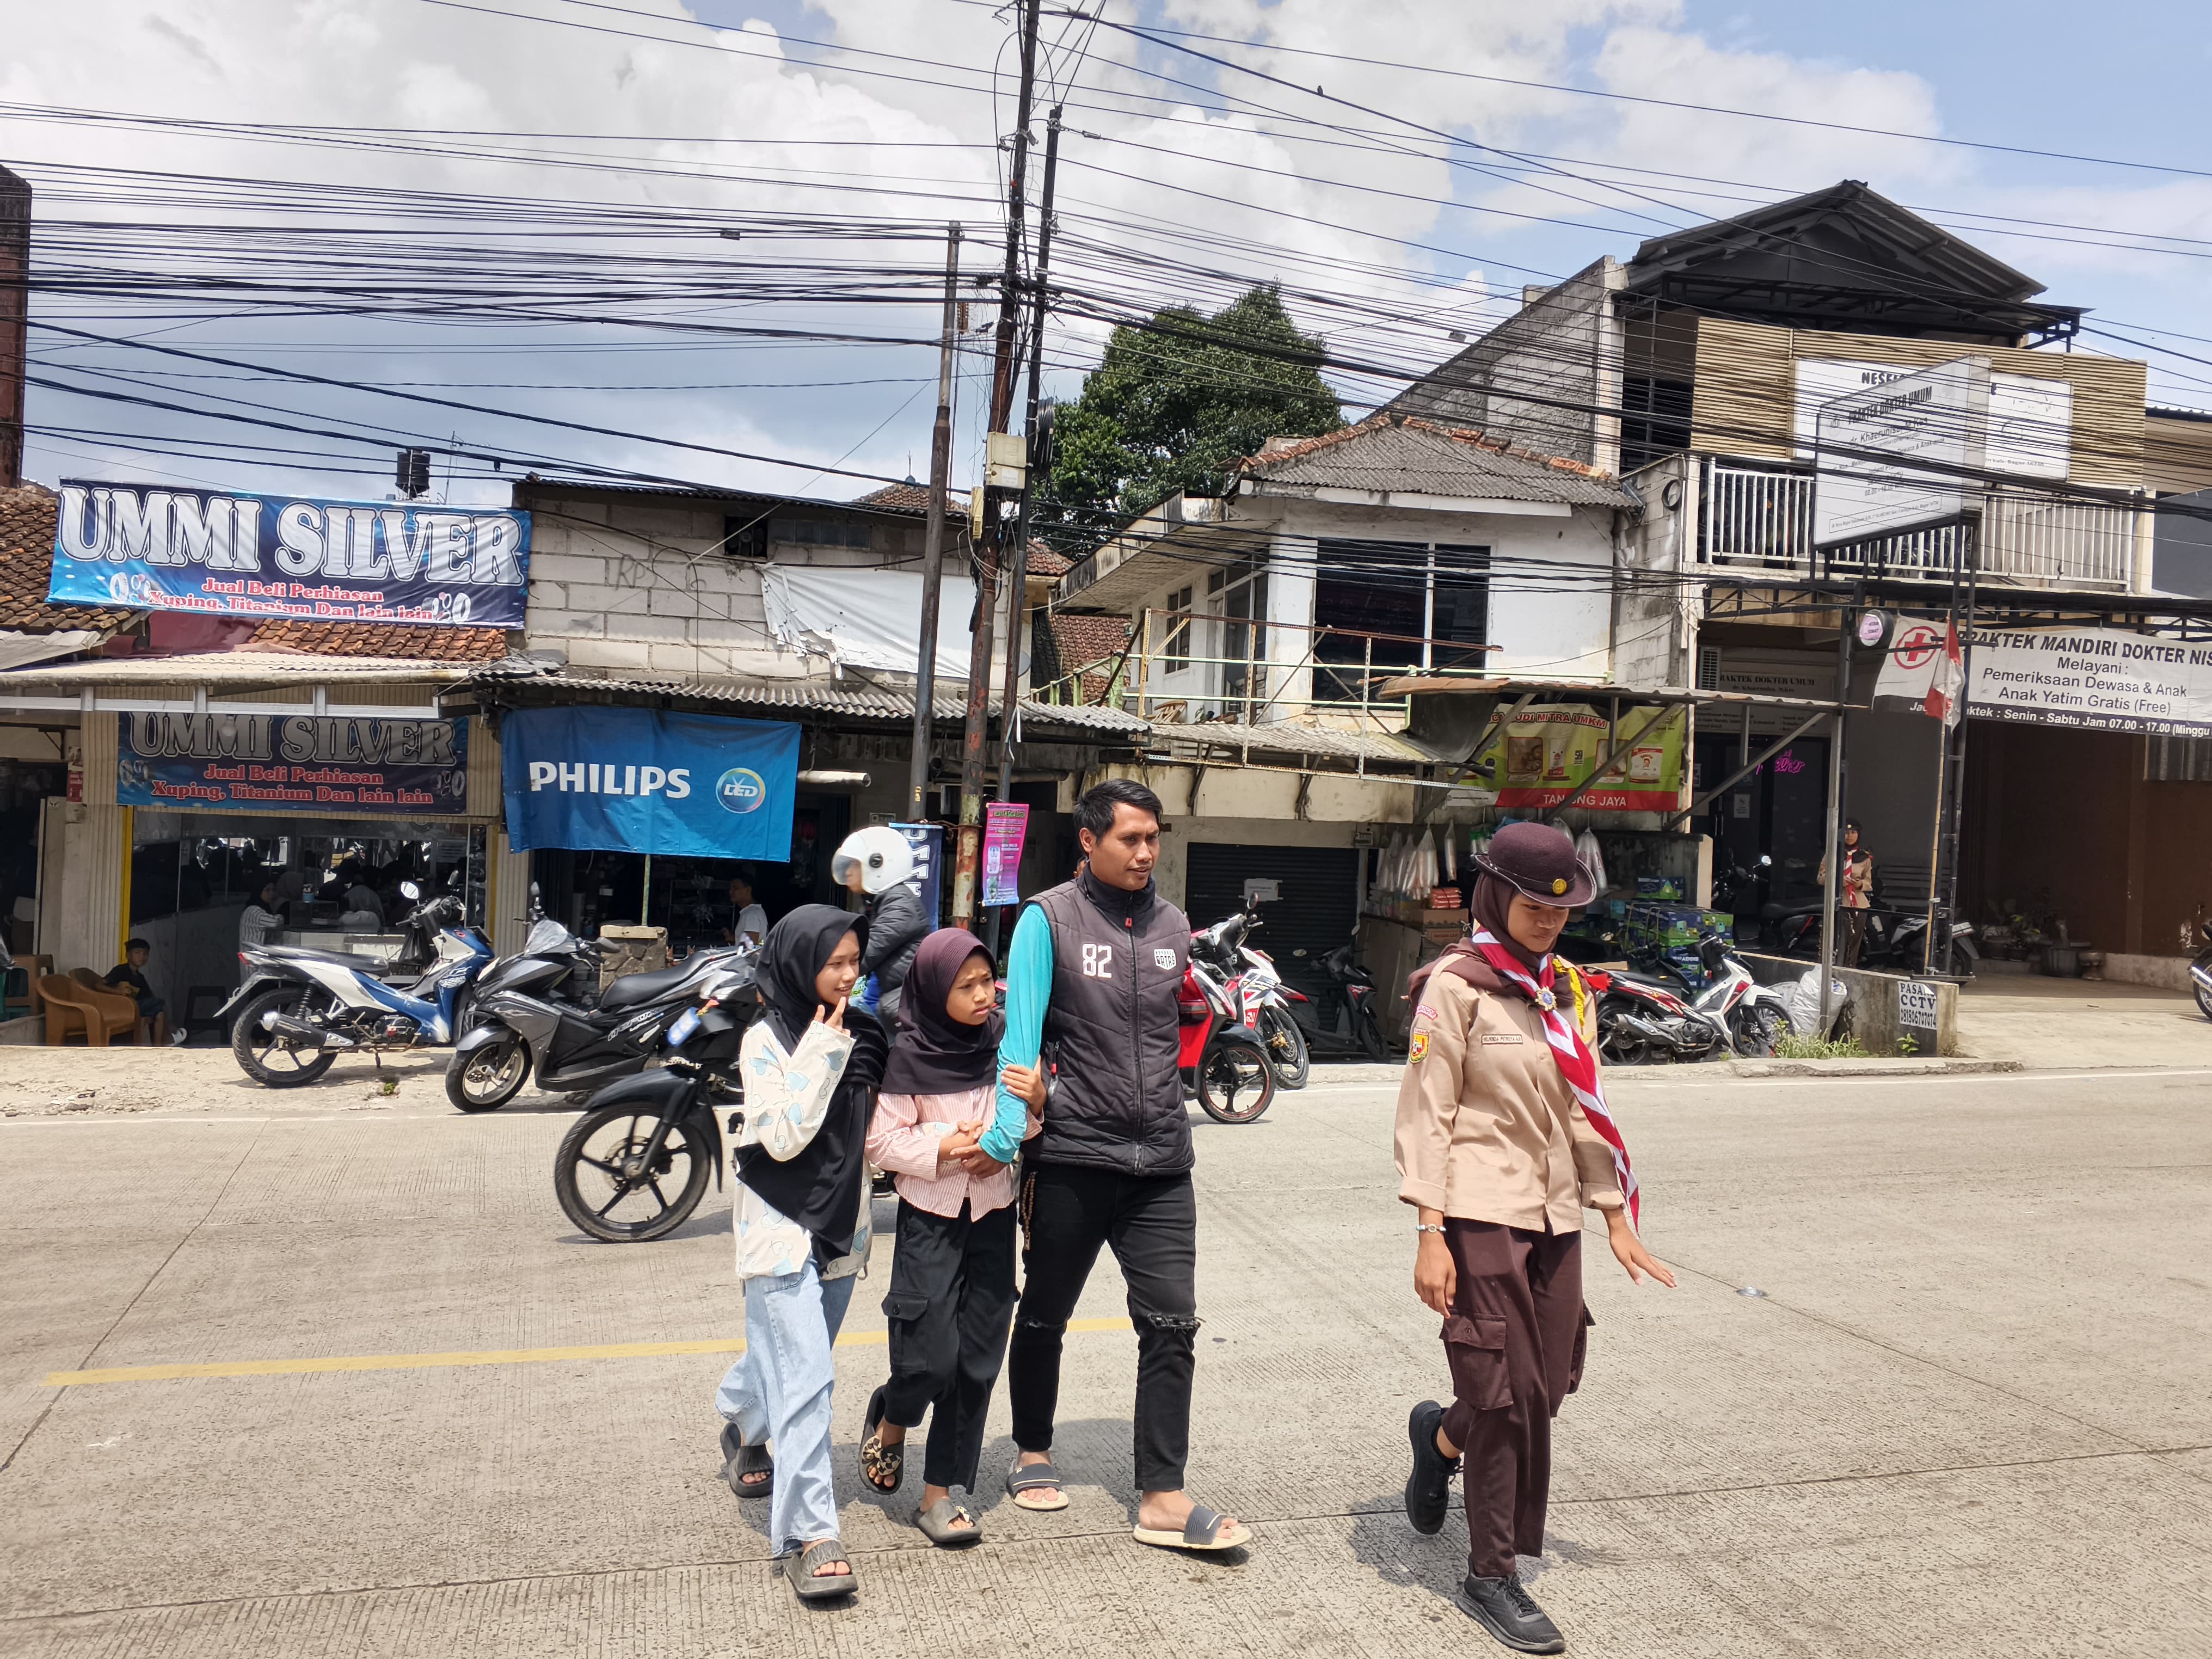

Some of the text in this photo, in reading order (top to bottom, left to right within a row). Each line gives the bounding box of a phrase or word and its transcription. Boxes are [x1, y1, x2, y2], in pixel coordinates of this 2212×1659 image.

[1908, 385, 1932, 406] UMUM
[59, 484, 524, 585] UMMI SILVER
[201, 577, 384, 602] Jual Beli Perhiasan
[228, 597, 311, 615] Titanium
[315, 603, 353, 617] Dan
[358, 605, 393, 618] lain
[397, 606, 434, 620] lain
[2040, 636, 2117, 656] MANDIRI
[2122, 643, 2185, 663] DOKTER
[1983, 667, 2187, 697] Pemeriksaan Dewasa & Anak
[1998, 686, 2171, 716] Anak Yatim Gratis (Free)
[1537, 712, 1571, 722] MITRA
[1573, 714, 1607, 728] UMKM
[2004, 709, 2037, 721] Senin
[2047, 712, 2080, 724] Sabtu
[2082, 716, 2106, 728] Jam
[2109, 718, 2137, 730] 07.00
[2146, 722, 2170, 733] 17.00
[2172, 724, 2210, 738] (Minggu
[130, 712, 456, 766] UMMI SILVER
[204, 763, 384, 785] Jual Beli Perhiasan
[529, 761, 758, 798] PHILIPS LED
[151, 781, 433, 804] Xuping, Titanium Dan lain lain
[1543, 794, 1627, 807] TANNG JAYA
[1082, 943, 1113, 978] 82
[1900, 983, 1934, 997] PASA
[1901, 994, 1936, 1010] CCTV
